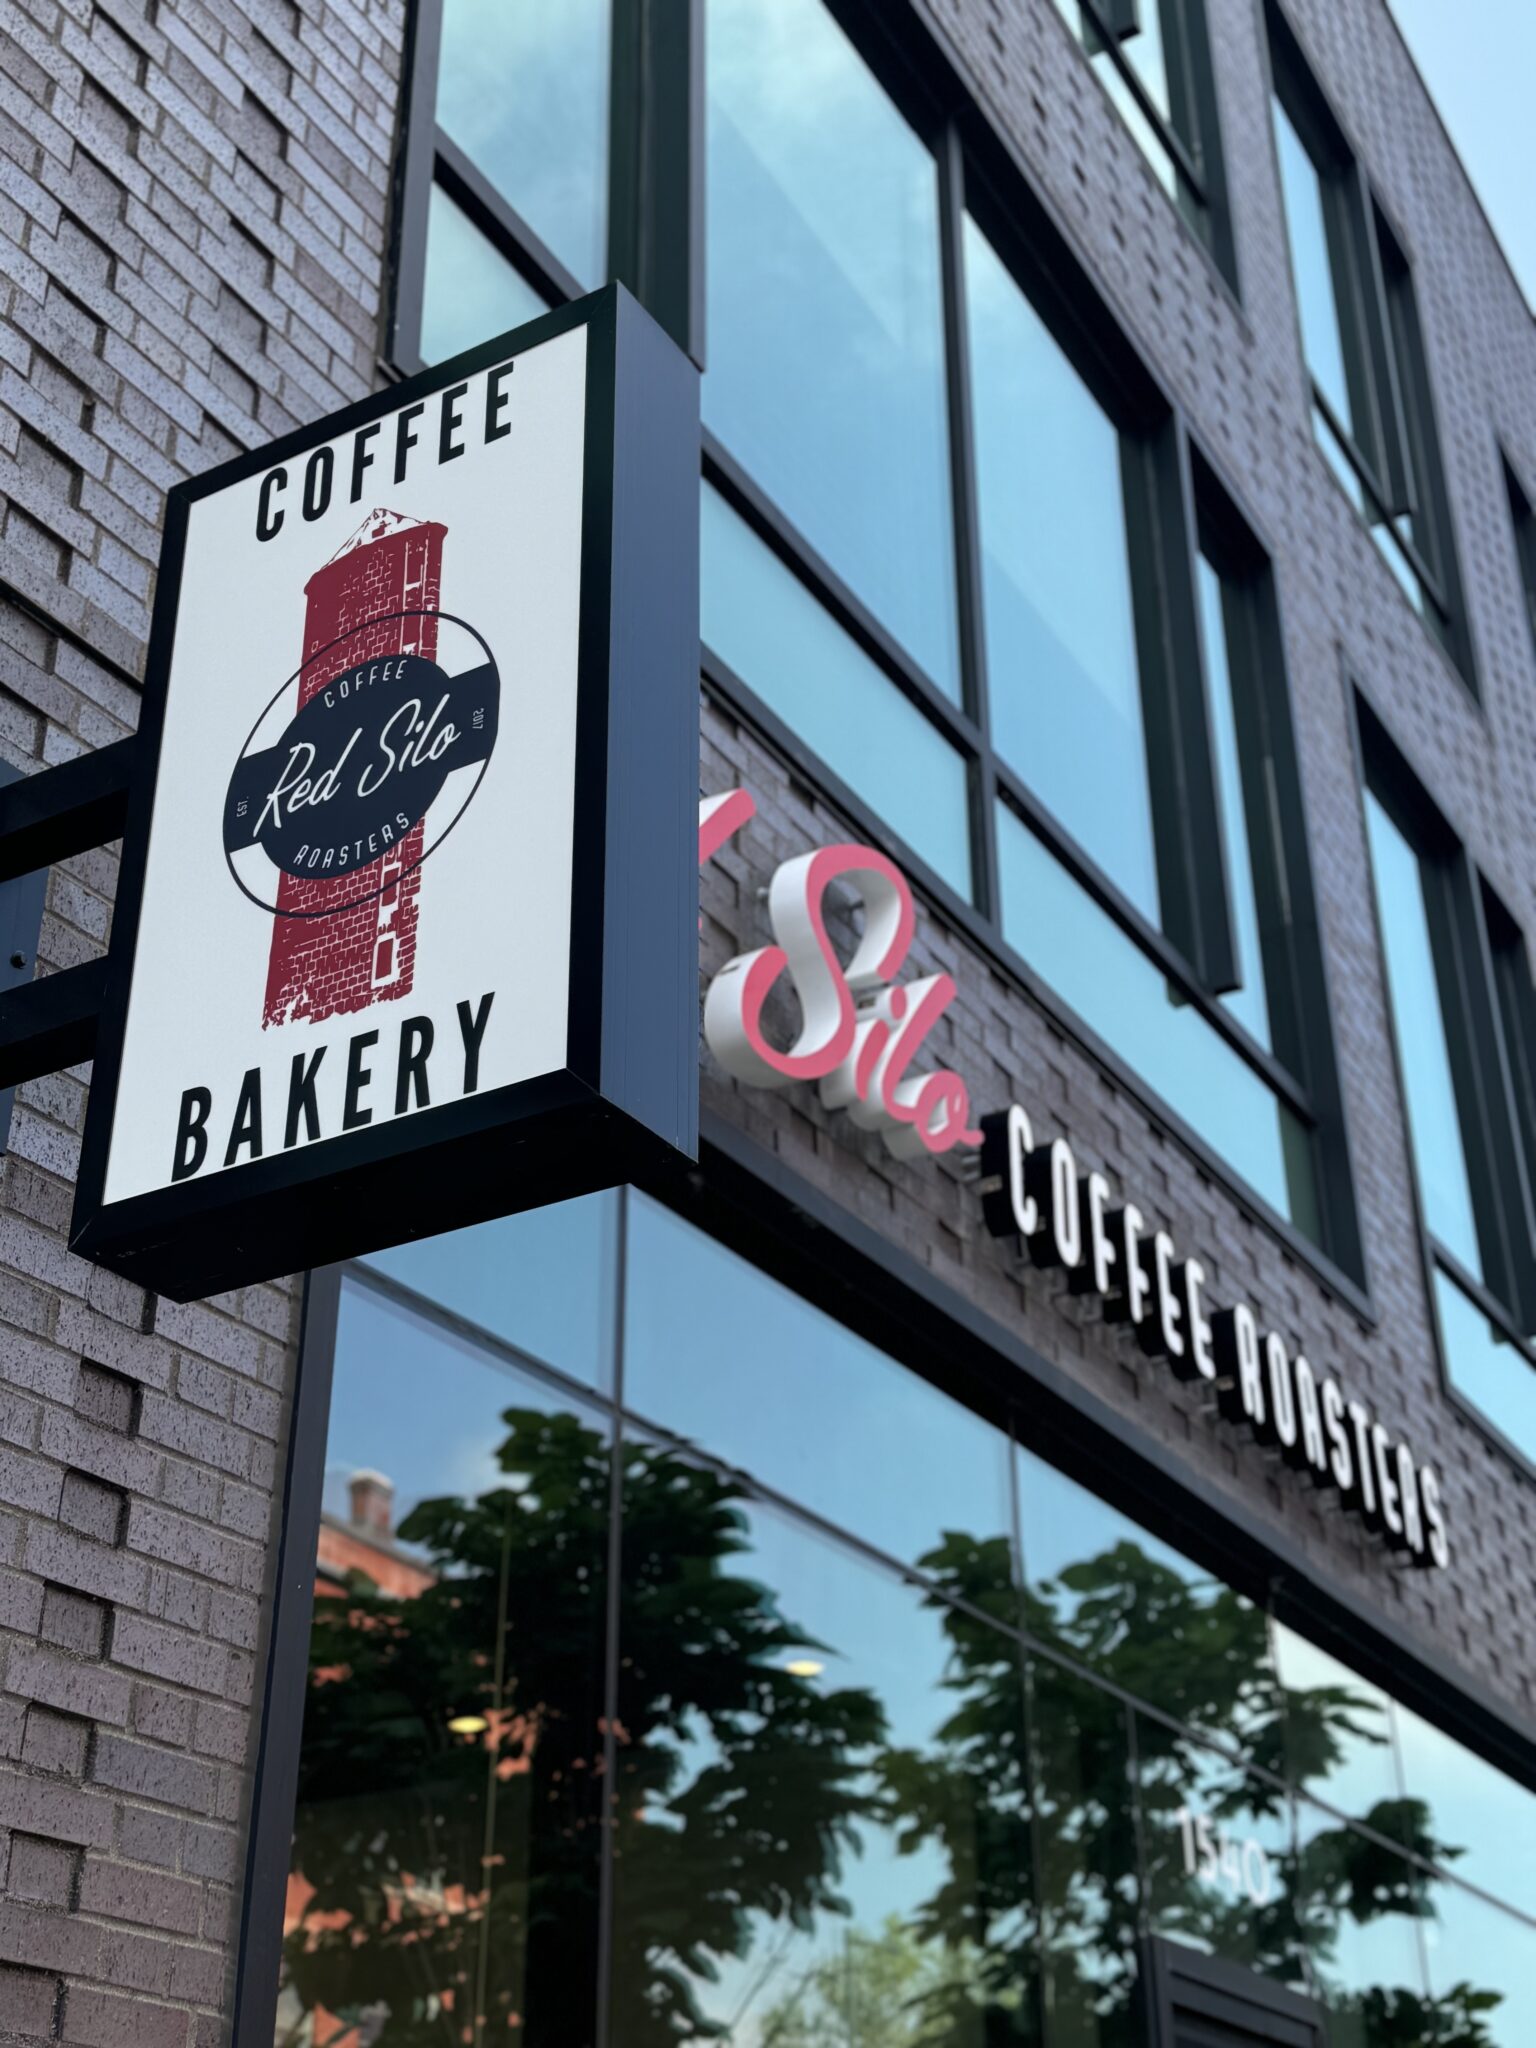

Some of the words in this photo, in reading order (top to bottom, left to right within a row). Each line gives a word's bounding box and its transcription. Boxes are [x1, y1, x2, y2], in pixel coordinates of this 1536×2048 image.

[256, 361, 514, 542] COFFEE
[324, 660, 407, 708] COFFEE
[472, 708, 484, 729] 2017
[253, 727, 363, 837] Red
[357, 693, 461, 797] Silo
[293, 812, 410, 868] ROASTERS
[706, 843, 985, 1155] Silo
[171, 991, 495, 1183] BAKERY
[1007, 1103, 1216, 1380] COFFEE
[1234, 1302, 1448, 1569] ROASTERS
[1176, 1806, 1269, 1906] 1540
